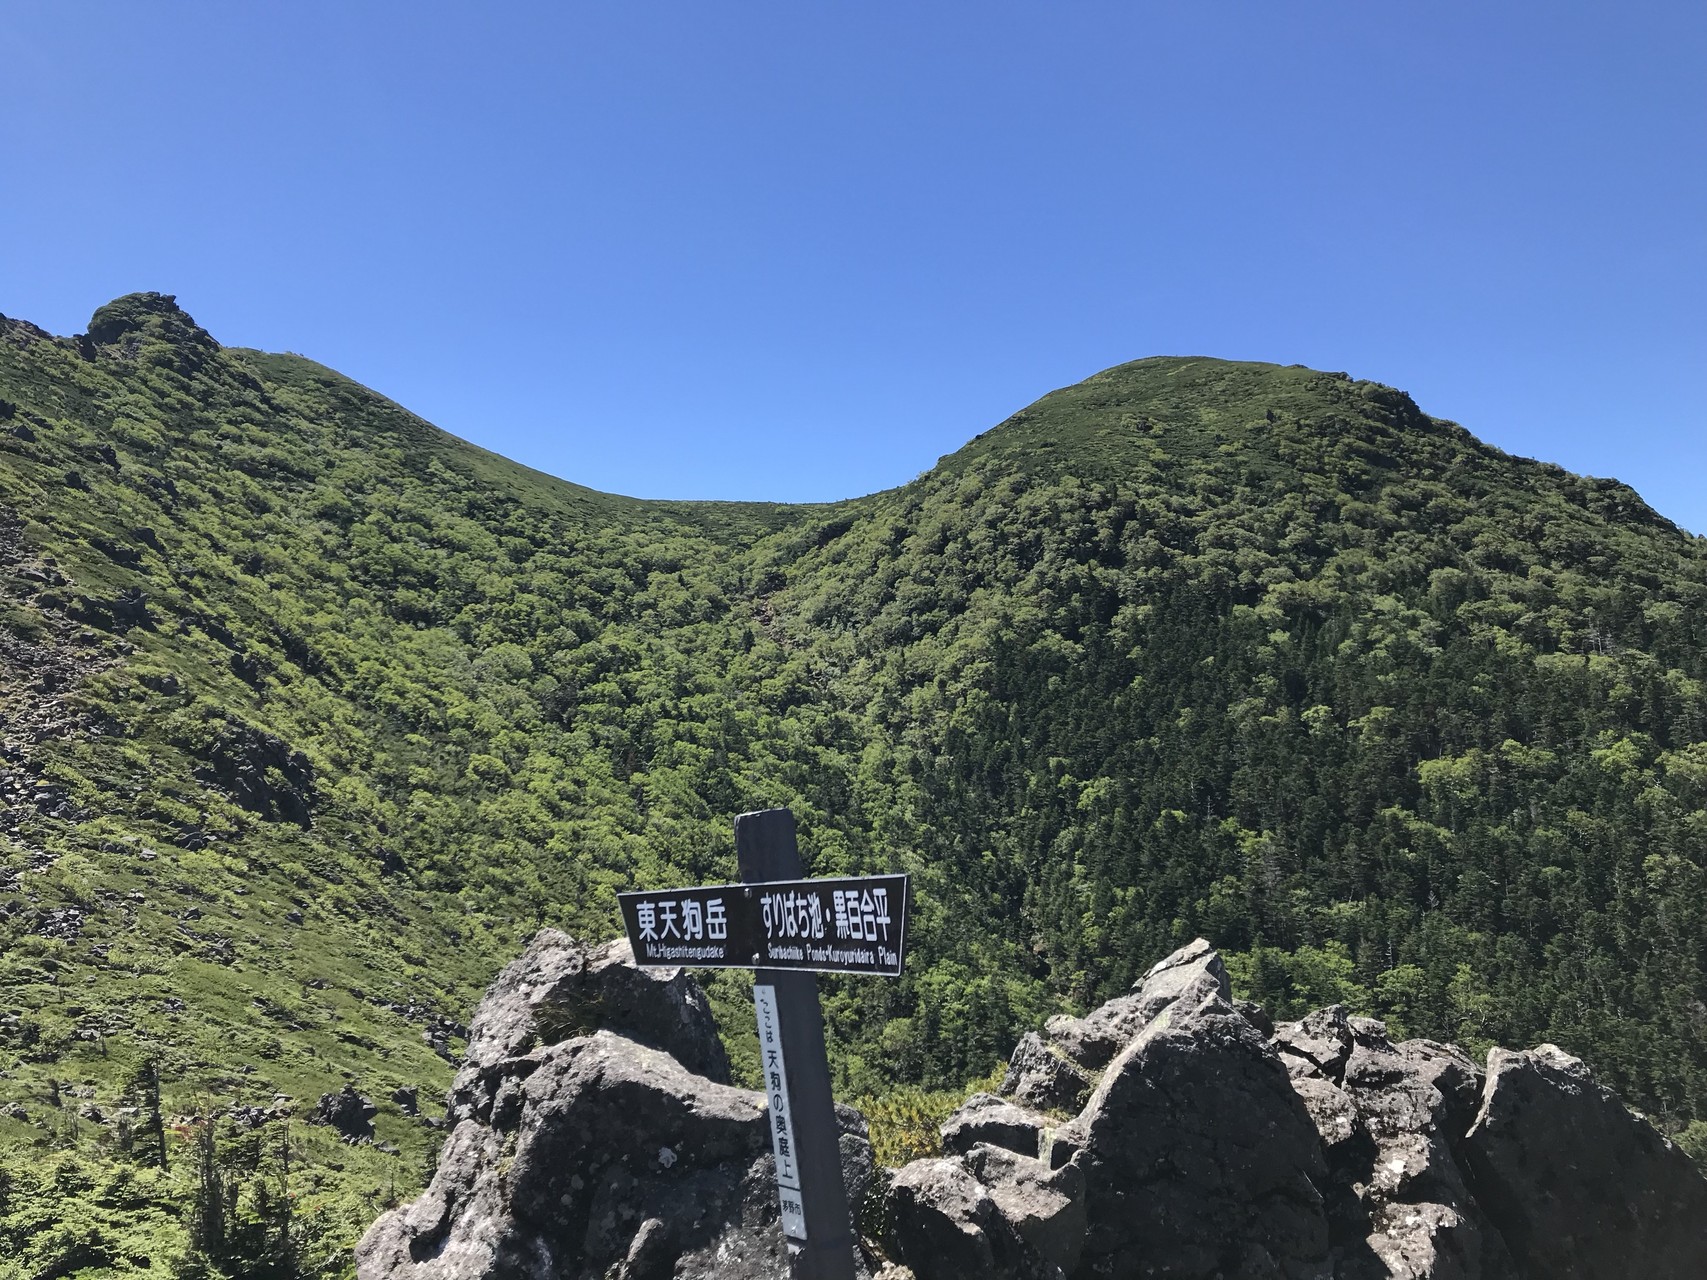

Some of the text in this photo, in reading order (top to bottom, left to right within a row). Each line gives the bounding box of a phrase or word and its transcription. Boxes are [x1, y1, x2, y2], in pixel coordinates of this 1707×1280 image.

[636, 897, 727, 942] 東天狗岳
[760, 888, 892, 942] すりばち池・黒百合平
[877, 946, 898, 966] Plain
